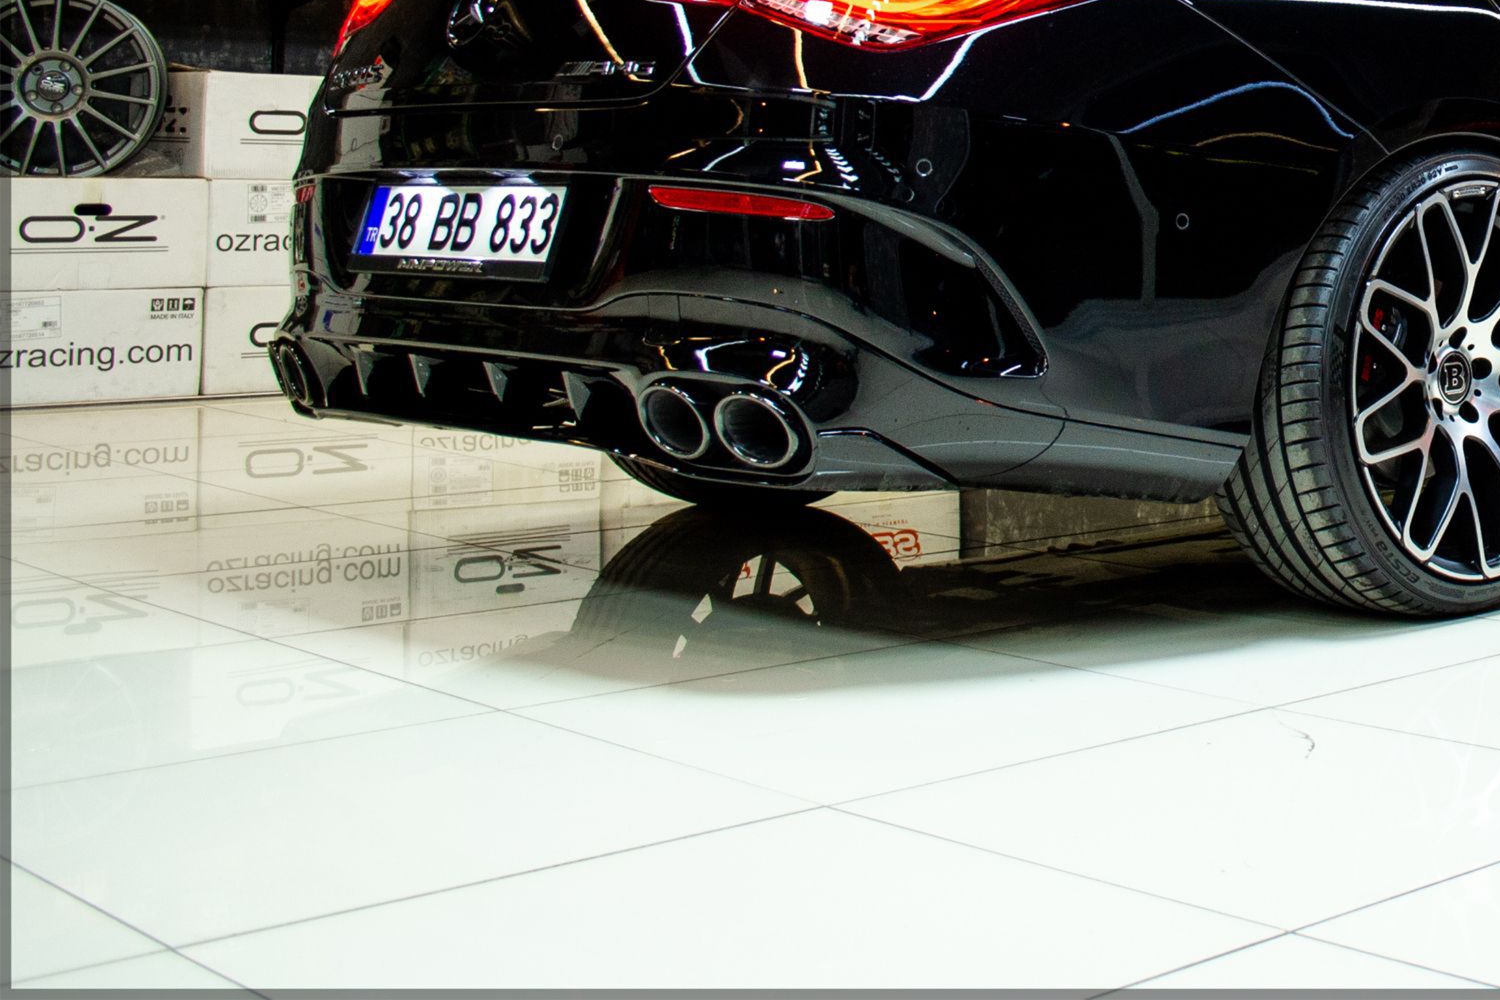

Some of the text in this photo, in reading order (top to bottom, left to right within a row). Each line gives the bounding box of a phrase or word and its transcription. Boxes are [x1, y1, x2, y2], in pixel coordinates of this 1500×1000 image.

[366, 227, 379, 242] TR
[380, 193, 560, 254] 38 BB 833
